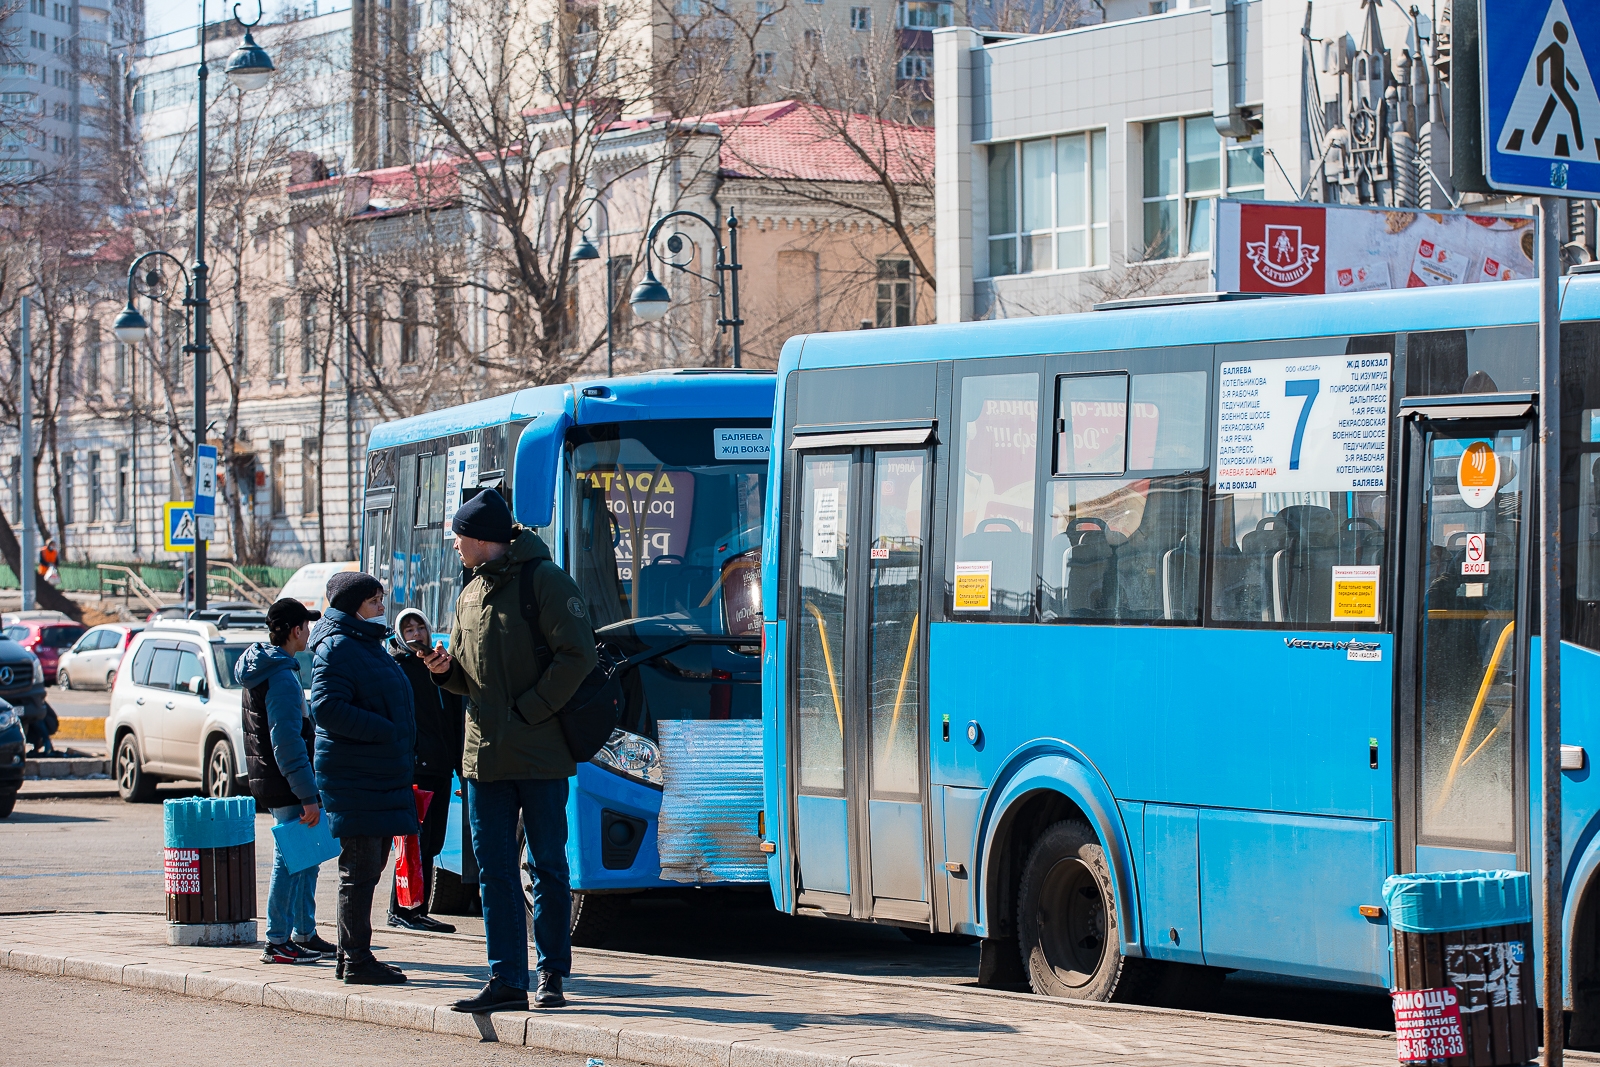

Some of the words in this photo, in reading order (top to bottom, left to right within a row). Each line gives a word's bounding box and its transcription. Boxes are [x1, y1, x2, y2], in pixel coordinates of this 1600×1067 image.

[1262, 265, 1304, 281] РАТИМИР
[1361, 358, 1388, 368] ВОКЗАЛ
[1223, 366, 1252, 375] БАЛЯЕВА
[1285, 365, 1296, 373] ООО
[1351, 372, 1359, 381] ТЦ
[1360, 371, 1388, 380] ИЗУМРУД
[1222, 377, 1267, 387] КОТЕЛЬНИКОВА
[1330, 381, 1370, 393] ПОКРОВСКИЙ
[1371, 383, 1388, 392] ПАРК
[1221, 390, 1231, 399] 3-Я
[1232, 389, 1259, 398] РАБОЧАЯ
[1349, 394, 1387, 405] ДАЛЬПРЕСС
[1221, 400, 1260, 410] ПЕДУЧИЛИЩЕ
[1221, 412, 1248, 421] ВОЕННОЕ
[1249, 411, 1270, 420] ШОССЕ
[1351, 407, 1365, 416] 1-АЯ
[1366, 406, 1386, 415] РЕЧКА
[1221, 422, 1265, 432] НЕКРАСОВСКАЯ
[1285, 379, 1320, 470] 7
[1338, 418, 1386, 428] НЕКРАСОВСКАЯ
[721, 433, 764, 441] БАЛЯЕВА
[1220, 434, 1233, 443] 1-АЯ
[1234, 434, 1252, 443] РЕЧКА
[1332, 430, 1361, 440] ВОЕННОЕ
[1362, 429, 1386, 439] ШОССЕ
[721, 446, 739, 455] Ж/Д
[740, 445, 771, 454] ВОКЗА
[1219, 445, 1254, 455] ДАЛЬПРЕСС
[1343, 441, 1385, 451] ПЕДУЧИЛИЩЕ
[1219, 455, 1257, 466] ПОКРОВСКИЙ
[1258, 456, 1273, 464] ПАРК
[1345, 453, 1355, 462] 3-Я
[1355, 453, 1385, 462] РАБОЧАЯ
[1219, 468, 1245, 477] КРАЕВАЯ
[1245, 467, 1277, 477] БОЛЬНИЦА
[1336, 465, 1384, 474] КОТЕЛЬНИКОВА
[1232, 481, 1257, 489] ВОКЗАЛ
[1352, 478, 1384, 487] БАЛЯЕВА
[872, 549, 888, 558] ВХОД
[1464, 563, 1486, 573] ВХОД
